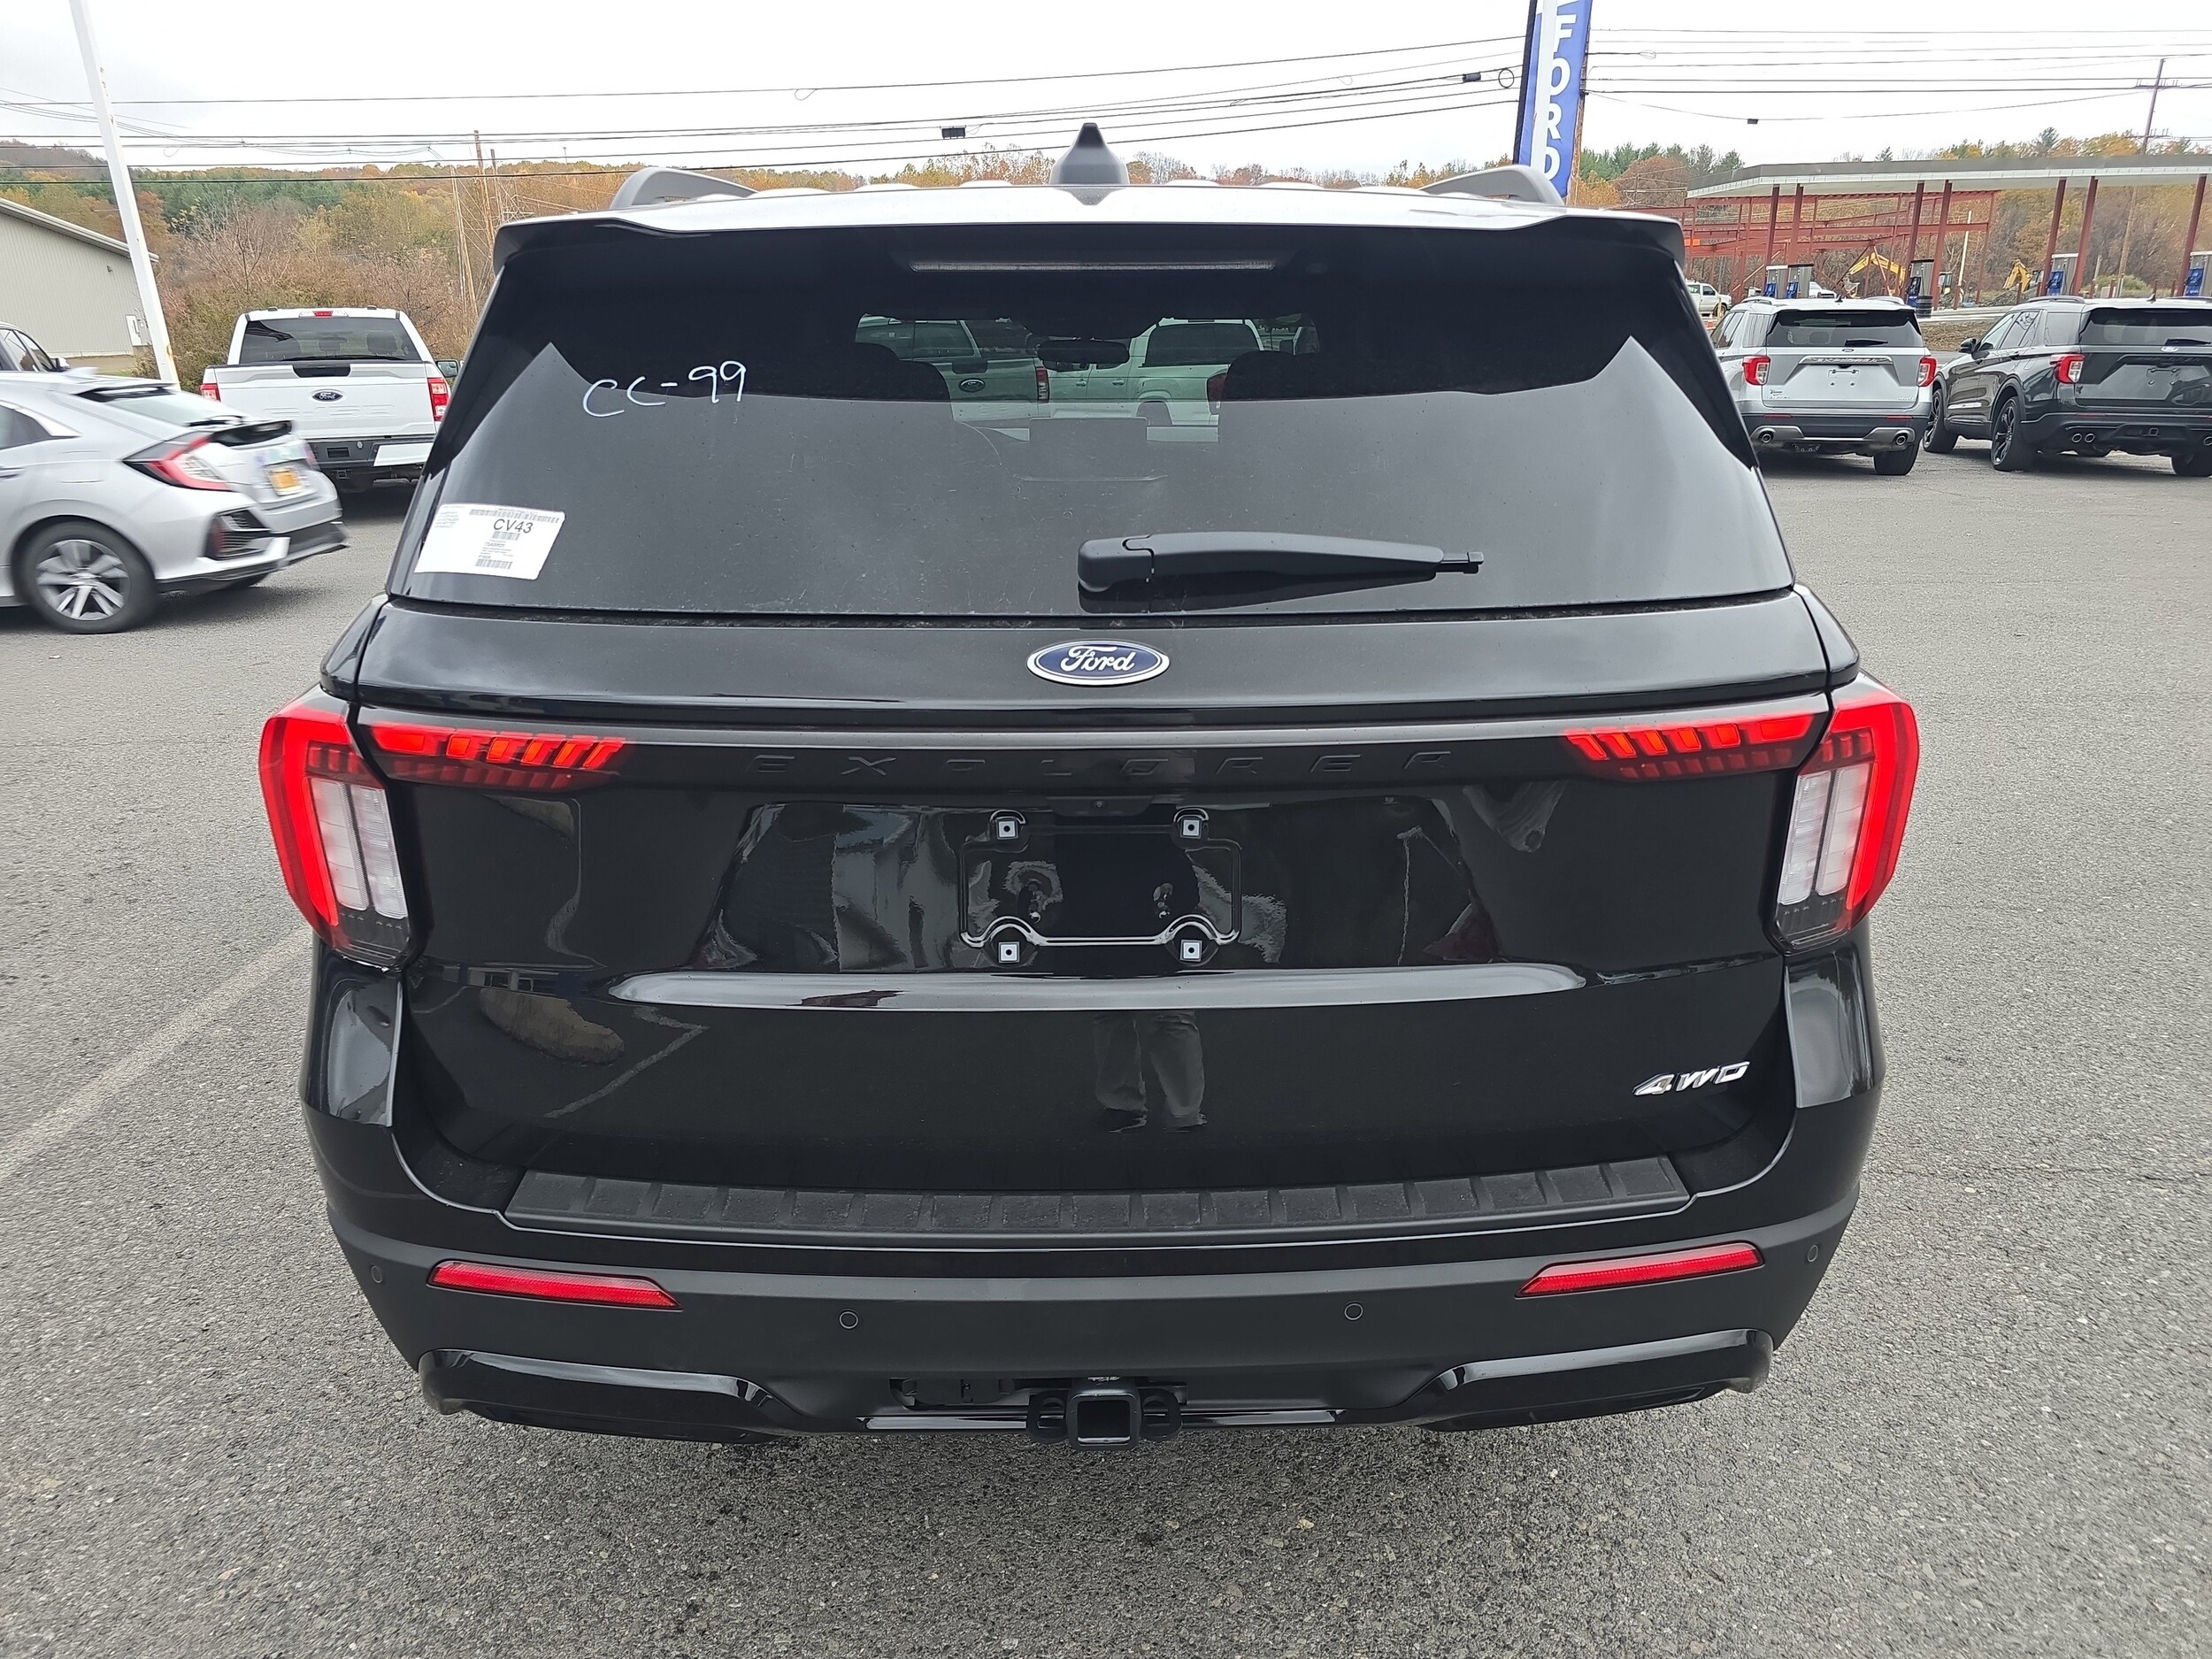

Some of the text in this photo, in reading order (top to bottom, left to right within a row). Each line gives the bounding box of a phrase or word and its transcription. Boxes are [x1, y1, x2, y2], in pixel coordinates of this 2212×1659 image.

[1543, 13, 1578, 181] FORD
[582, 360, 747, 418] CC-99
[493, 518, 534, 534] CV43
[1060, 645, 1137, 672] Ford
[743, 750, 1452, 776] EXPLORER
[1632, 1061, 1750, 1095] 4WD
